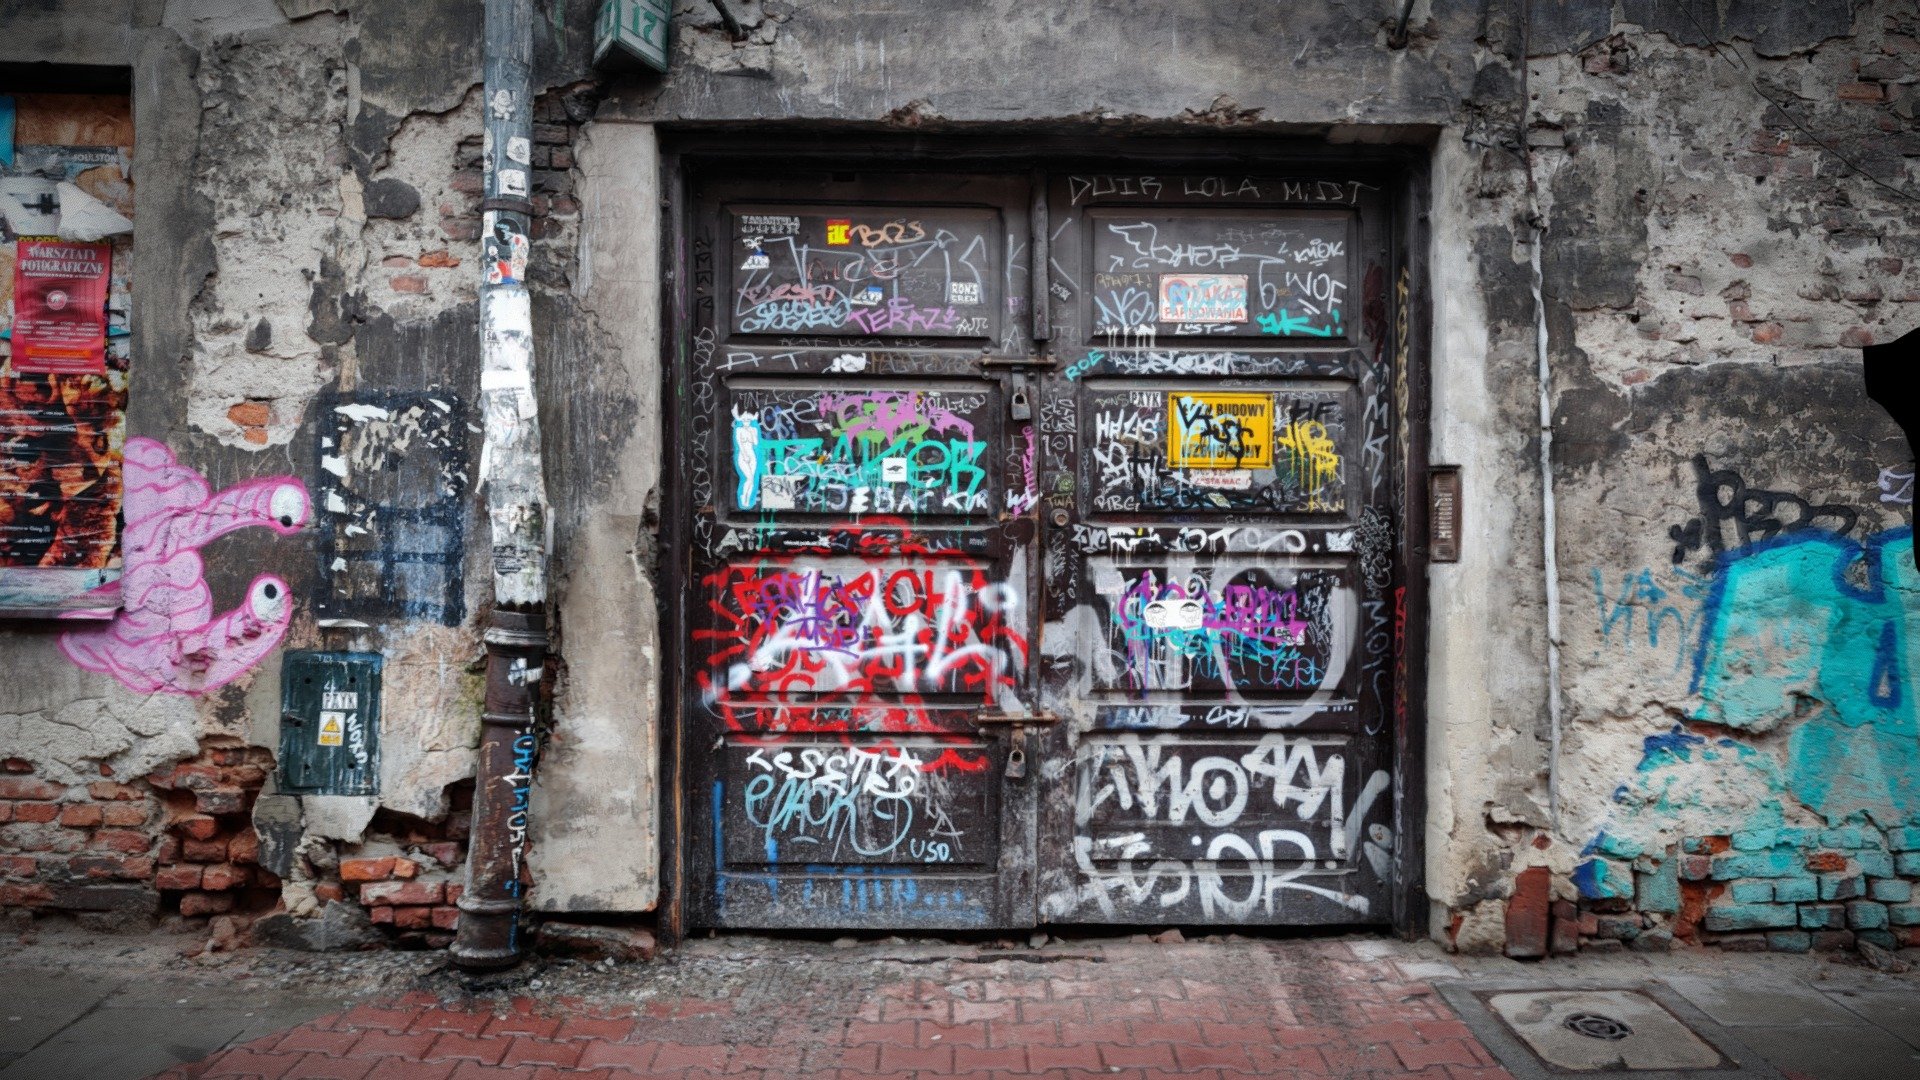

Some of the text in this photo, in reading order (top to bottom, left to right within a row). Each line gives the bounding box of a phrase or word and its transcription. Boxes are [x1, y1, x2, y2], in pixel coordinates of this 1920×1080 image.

[632, 3, 658, 45] 17
[1184, 177, 1261, 199] LOLA
[28, 246, 97, 260] WARSZTATY
[21, 260, 104, 274] FOTOGRAFICZNE
[1216, 403, 1265, 417] BUDOWY
